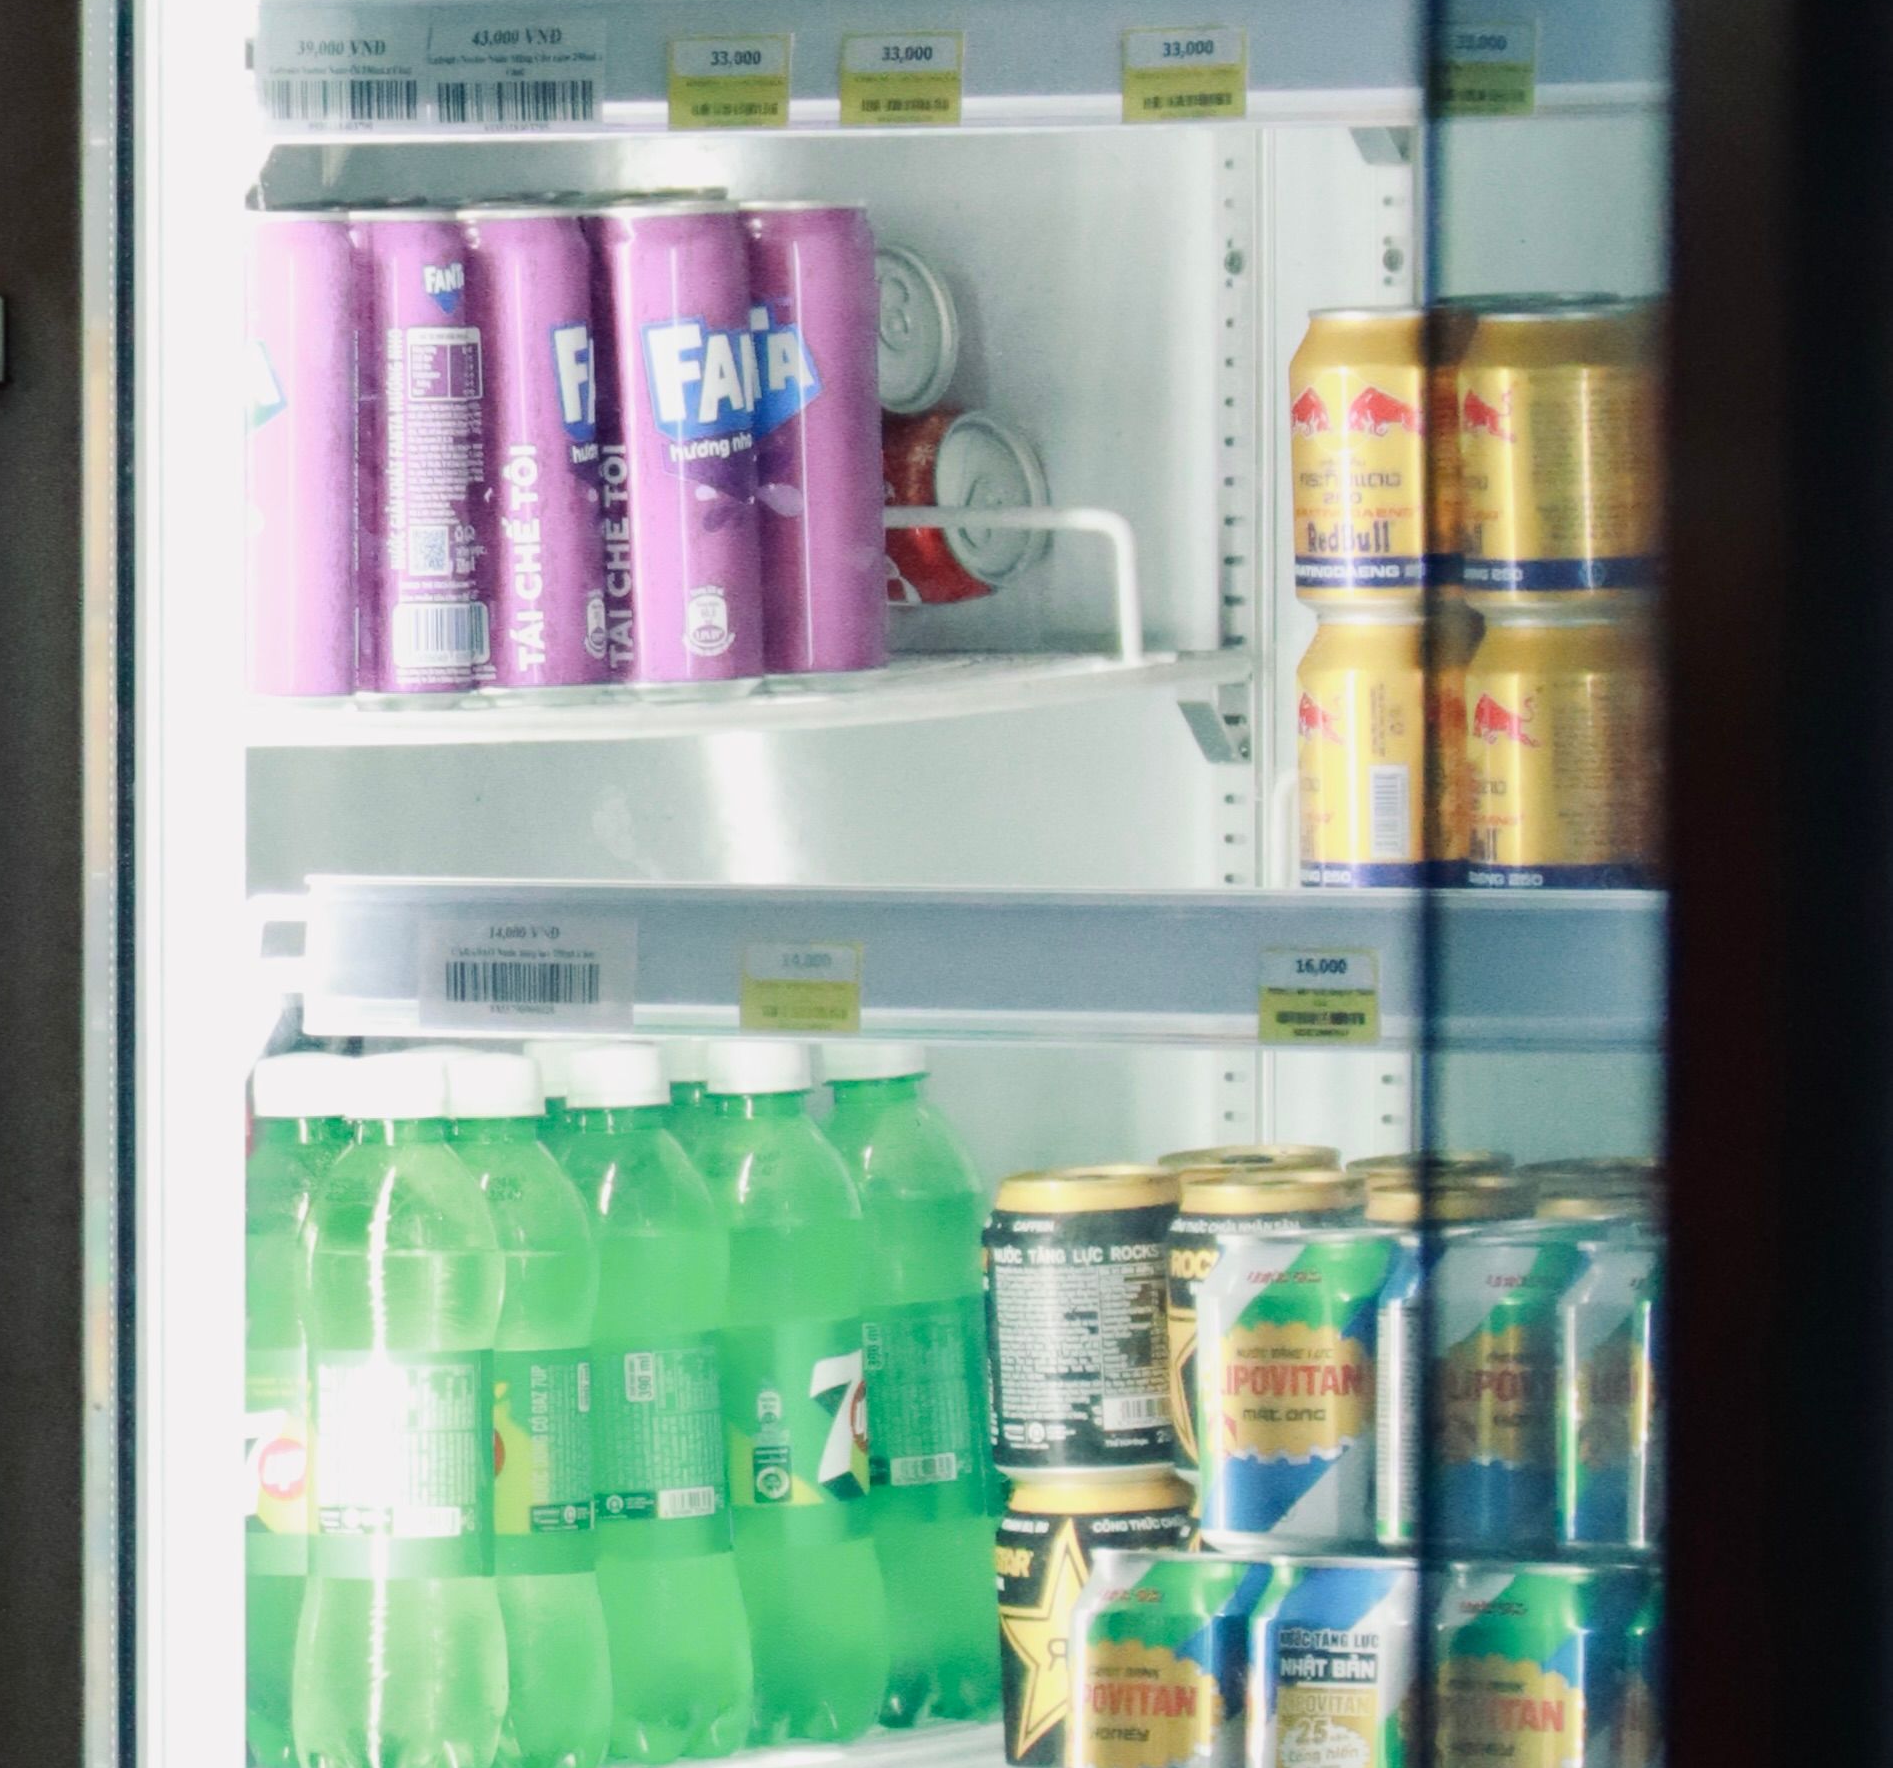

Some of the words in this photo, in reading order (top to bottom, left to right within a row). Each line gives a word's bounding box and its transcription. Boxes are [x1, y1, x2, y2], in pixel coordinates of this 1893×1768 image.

[881, 45, 934, 63] 33,000
[1161, 39, 1215, 59] 33,000
[710, 50, 762, 67] 33,000
